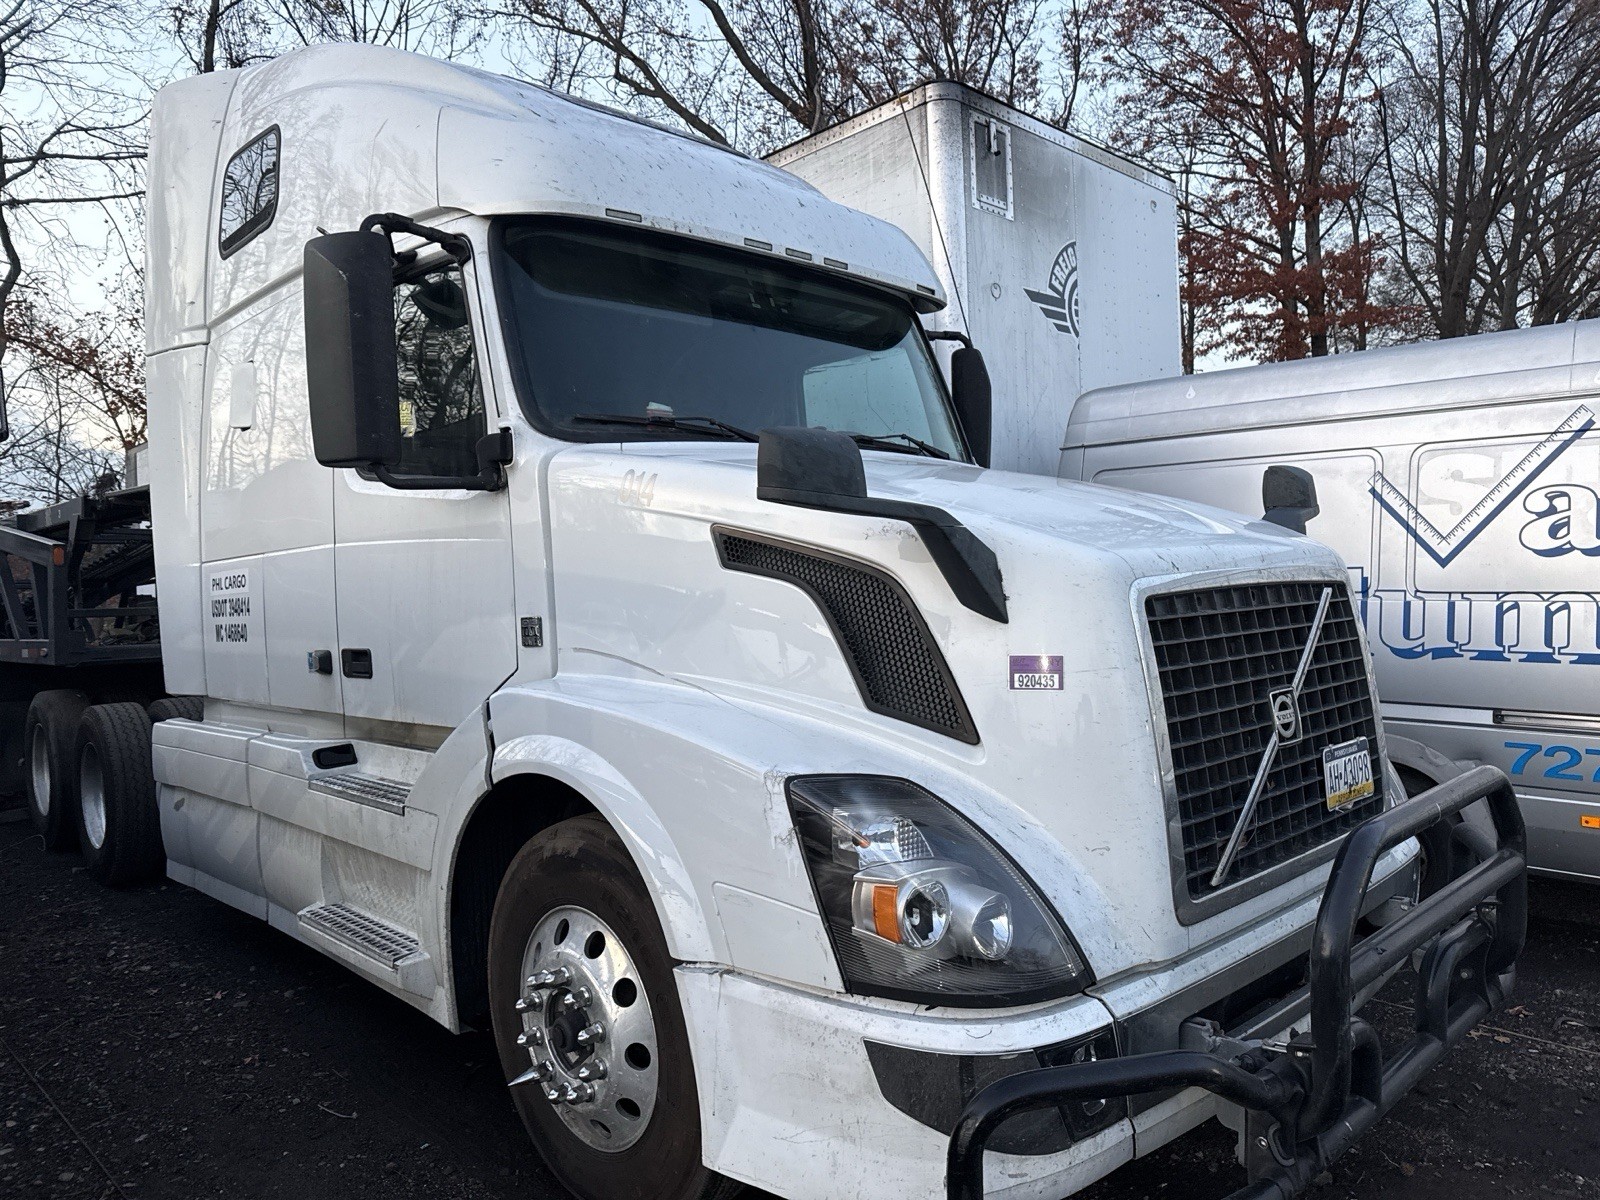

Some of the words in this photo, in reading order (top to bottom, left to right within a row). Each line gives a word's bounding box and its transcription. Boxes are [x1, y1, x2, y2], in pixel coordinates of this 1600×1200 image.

[211, 577, 223, 591] PHL
[225, 574, 246, 590] CARGO
[211, 598, 228, 617] USDOT
[1018, 674, 1055, 688] 920435
